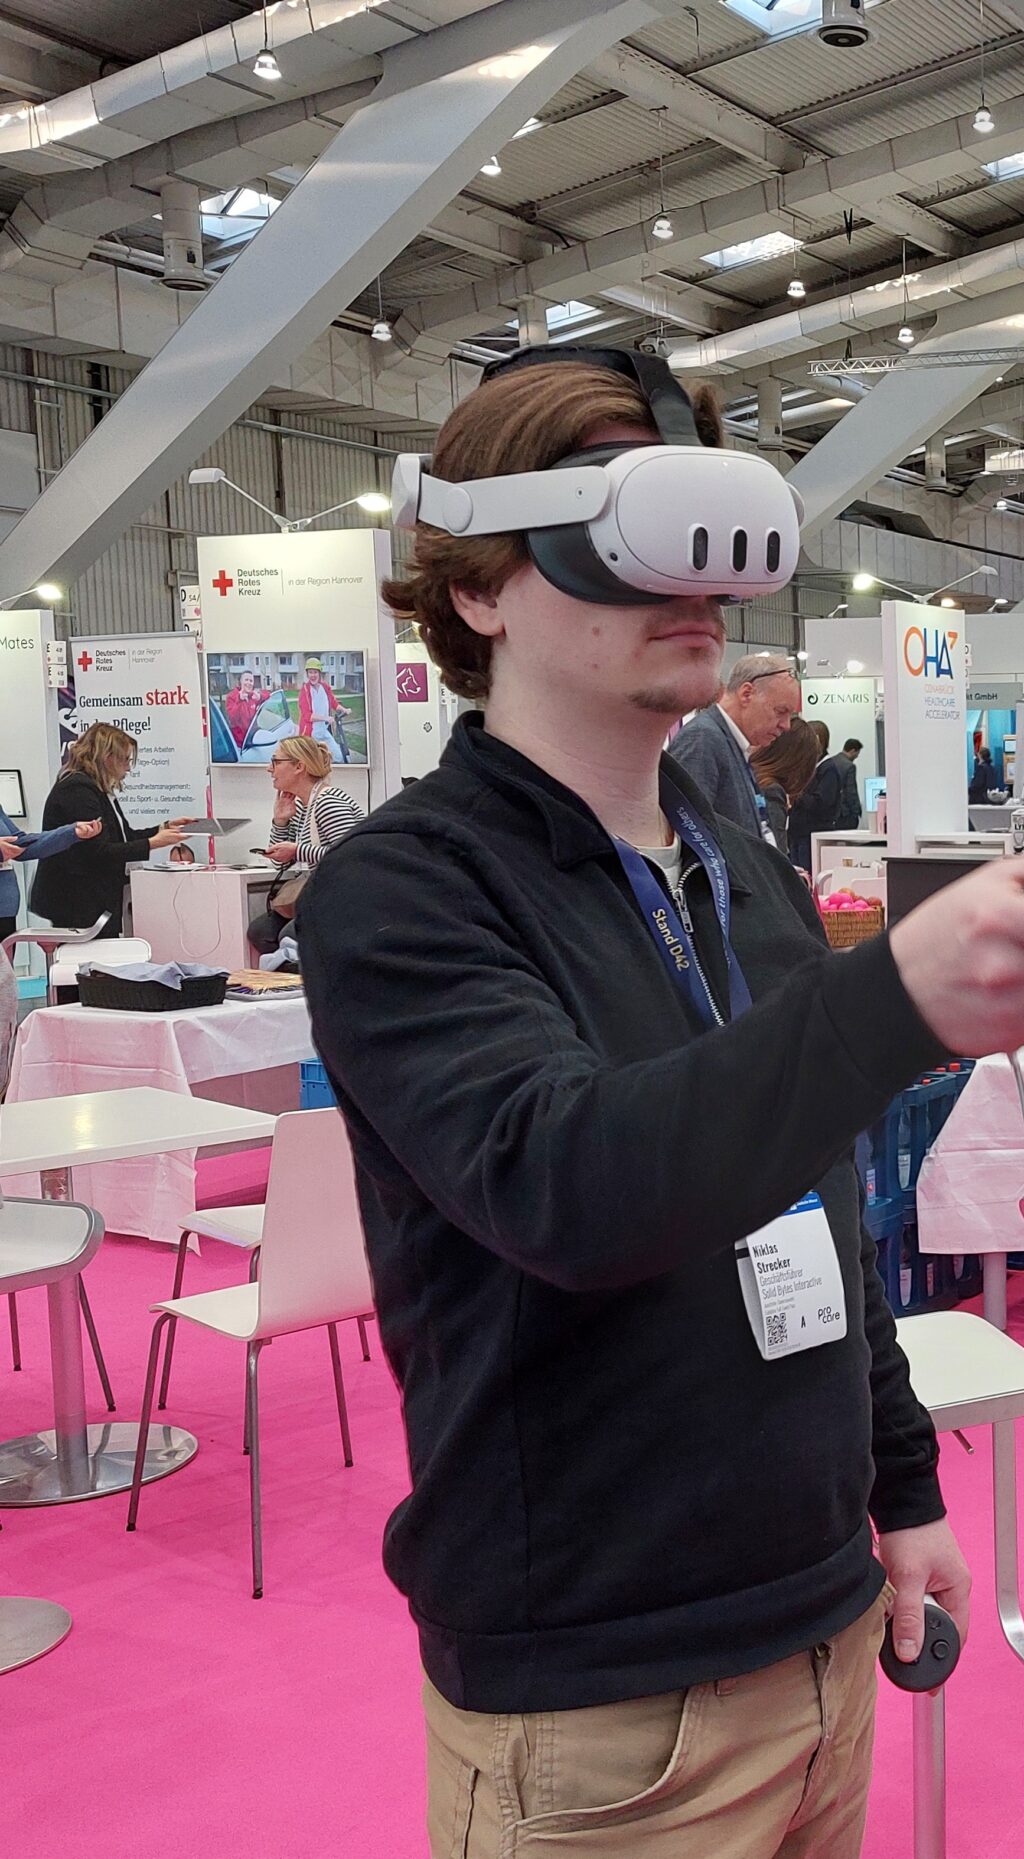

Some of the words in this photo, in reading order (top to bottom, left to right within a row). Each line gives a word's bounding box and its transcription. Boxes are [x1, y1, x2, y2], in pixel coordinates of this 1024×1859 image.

[237, 568, 279, 577] Deutsches
[238, 578, 261, 586] Rotes
[307, 577, 331, 587] Region
[332, 576, 364, 584] Hannover
[238, 588, 261, 596] Kreuz
[95, 649, 126, 657] Deutsches
[146, 648, 163, 656] Region
[79, 694, 143, 708] Gemeinsam
[146, 685, 190, 707] stark
[823, 693, 870, 704] ZENARIS
[974, 692, 998, 701] GmbH
[113, 716, 151, 735] Pflege!
[676, 806, 697, 832] others
[701, 842, 716, 859] care
[709, 857, 724, 877] who
[716, 878, 727, 909] those
[652, 908, 680, 945] Stand
[669, 943, 690, 972] D42
[752, 1243, 779, 1259] Niklas
[756, 1258, 791, 1274] Strecker
[762, 1286, 777, 1300] Solid
[777, 1284, 794, 1297] Bytes
[794, 1277, 823, 1292] Interactive
[818, 1306, 832, 1320] pro
[822, 1311, 841, 1324] care
[800, 1315, 807, 1329] A
